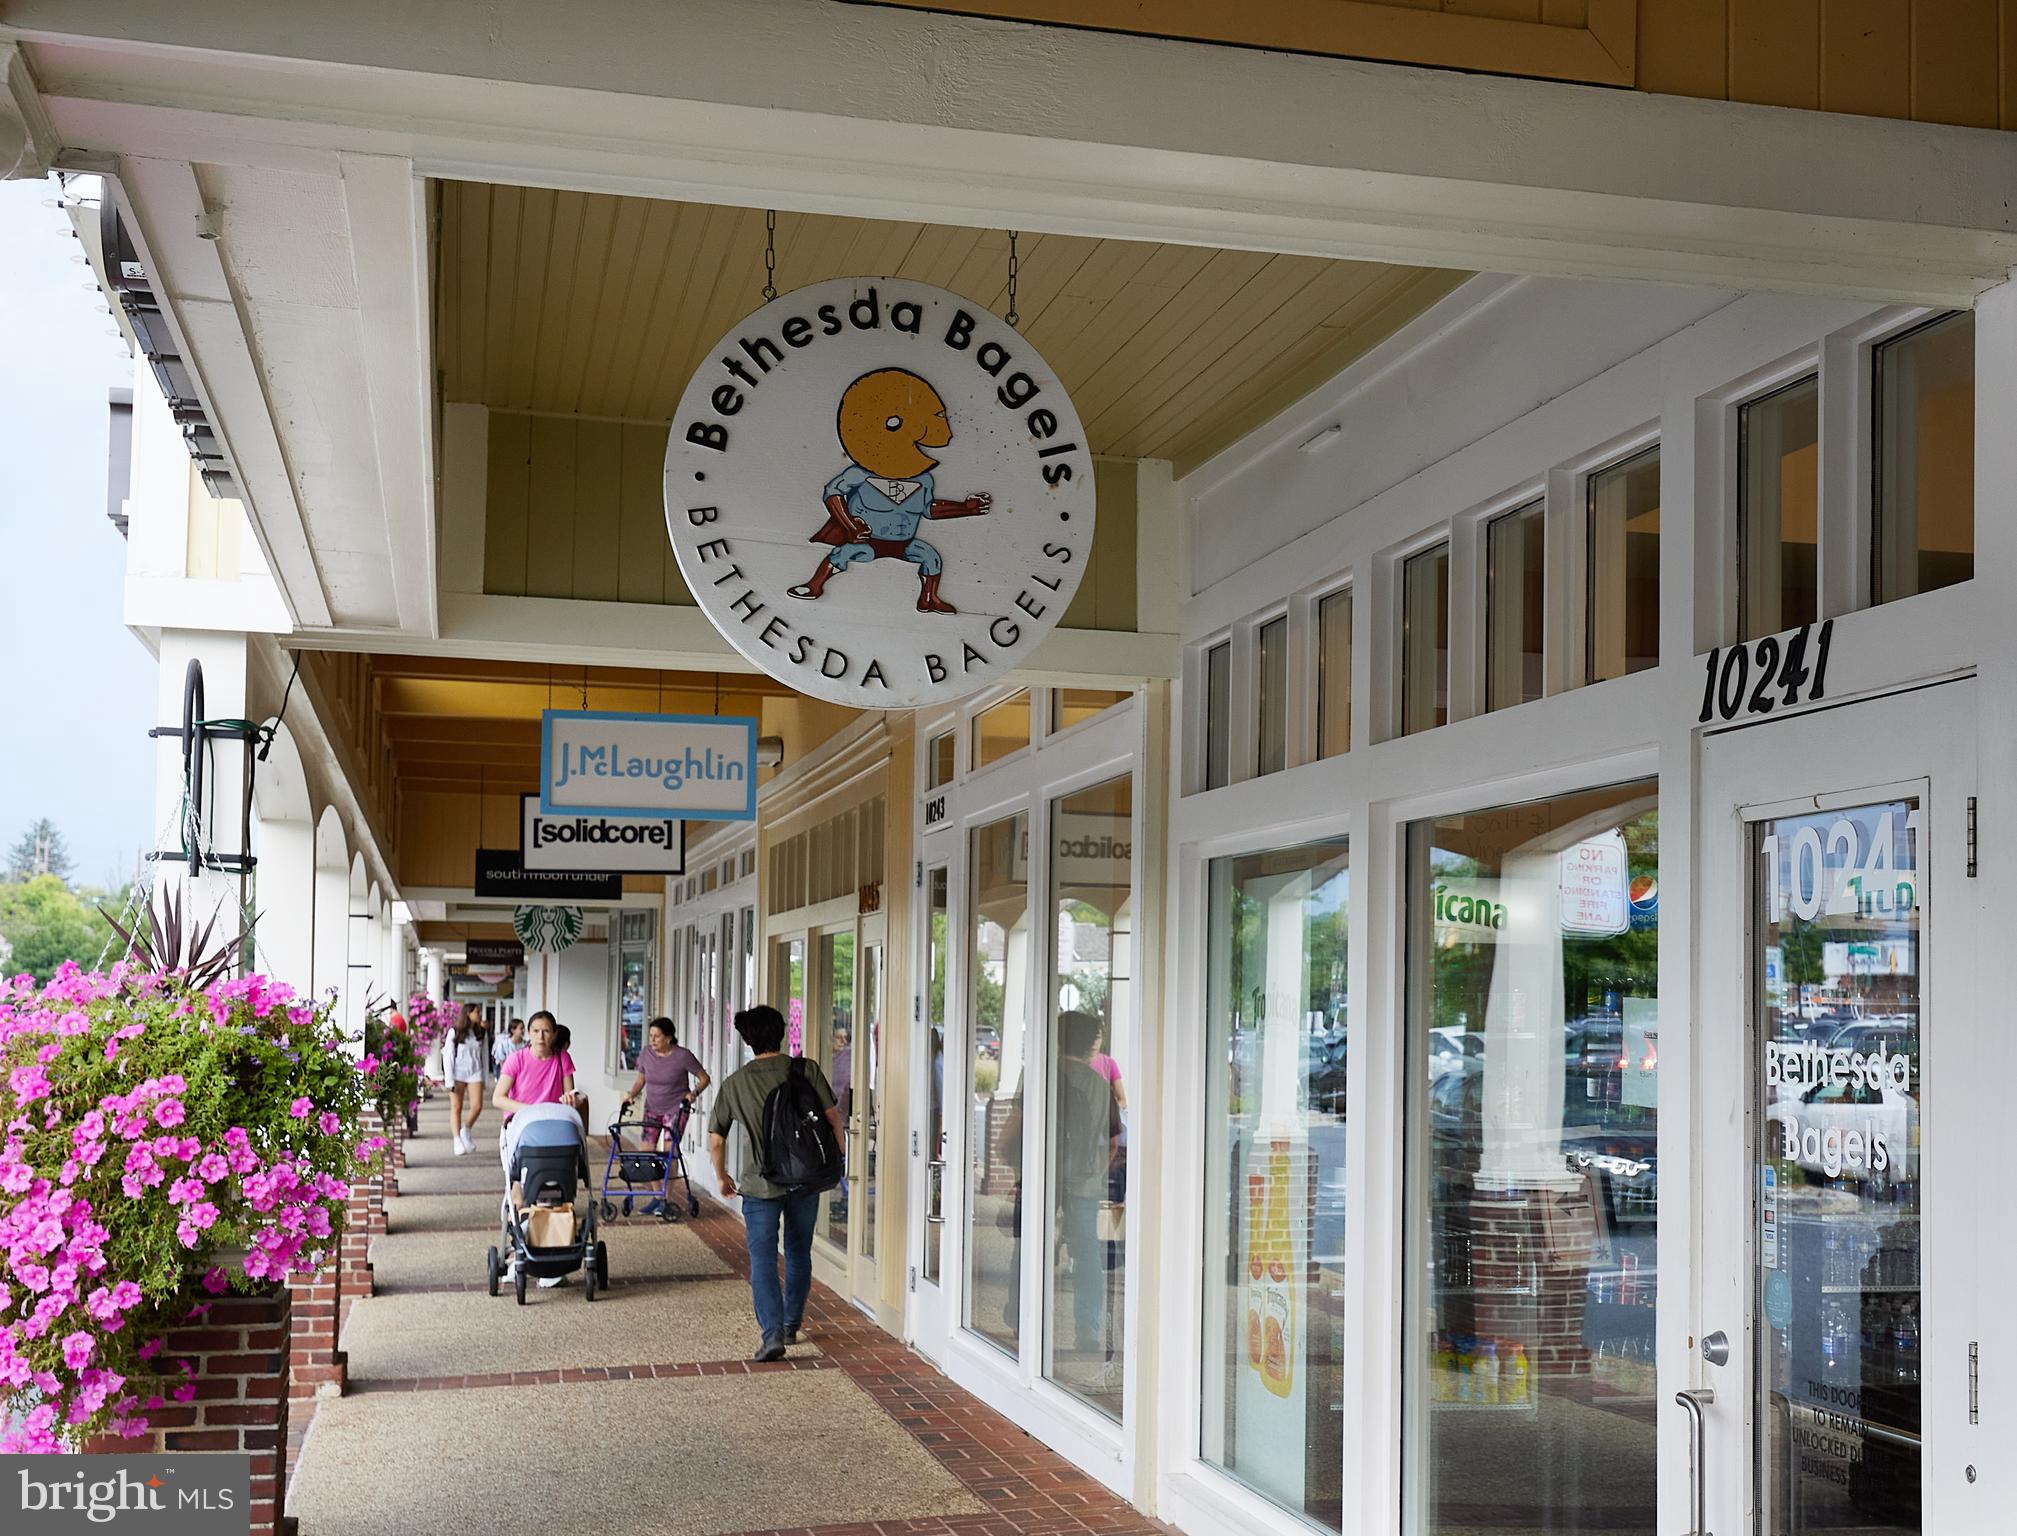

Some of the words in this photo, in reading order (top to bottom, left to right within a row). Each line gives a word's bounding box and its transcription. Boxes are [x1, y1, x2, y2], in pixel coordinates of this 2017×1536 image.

[685, 285, 923, 453] Bethesda
[944, 308, 1078, 486] Bagels
[688, 505, 889, 689] BETHESDA
[924, 541, 1072, 684] BAGELS
[1698, 619, 1834, 723] 10241
[555, 742, 744, 790] J.McLaughlin
[533, 817, 673, 851] [solidcore]
[1766, 1040, 1910, 1091] Bethesda
[1785, 1115, 1888, 1178] Bagels
[1807, 1380, 1828, 1401] THIS
[1812, 1407, 1826, 1426] TO
[1793, 1427, 1847, 1459] UNLOCKED
[1801, 1455, 1847, 1486] BUSINESS
